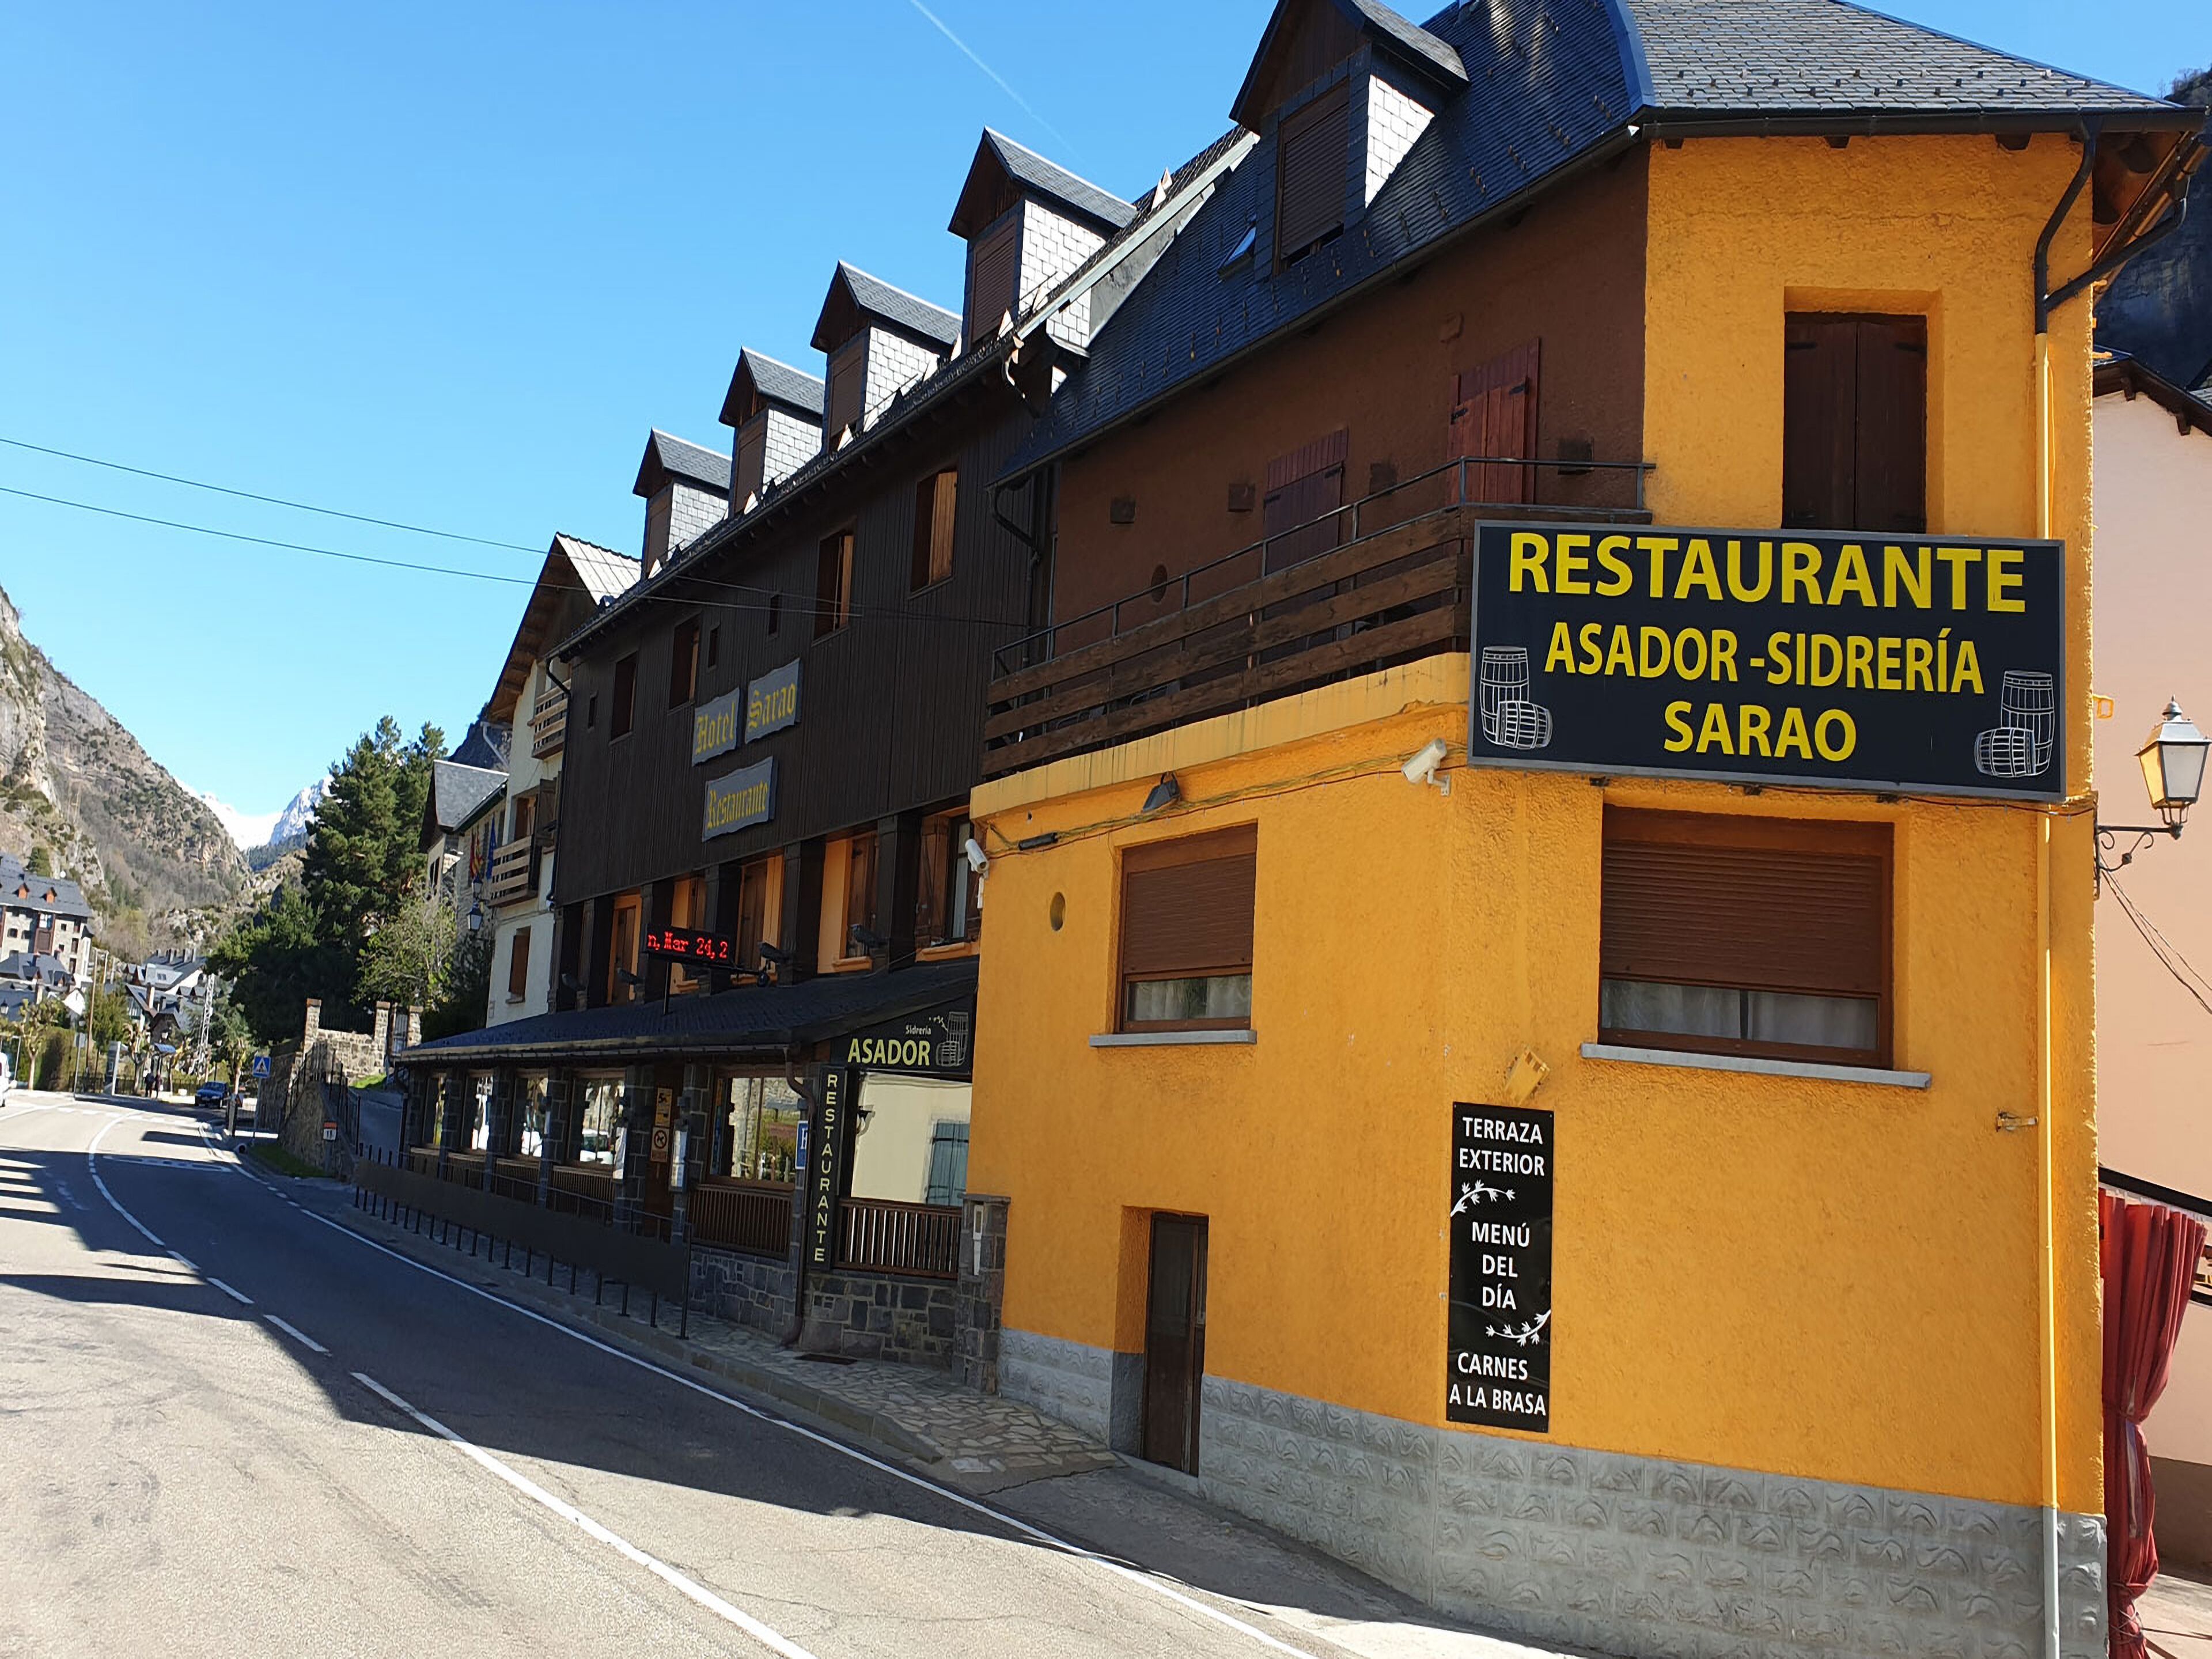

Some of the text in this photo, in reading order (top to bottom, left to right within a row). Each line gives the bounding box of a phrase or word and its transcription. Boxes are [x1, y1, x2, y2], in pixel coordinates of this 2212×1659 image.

[1509, 532, 2026, 613] RESTAURANTE
[1544, 621, 1738, 683] ASADOR
[695, 682, 797, 755] Hotel Sarao
[1664, 700, 1857, 762] SARAO
[707, 780, 768, 830] Restaurante
[664, 931, 689, 952] Mar
[847, 1038, 931, 1066] ASADOR
[1462, 1116, 1544, 1145] TERRAZA
[814, 1074, 838, 1262] RESTAURANTE
[1459, 1147, 1545, 1176] EXTERIOR
[1472, 1221, 1530, 1248] MENÚ
[1482, 1253, 1518, 1278] DEL
[1482, 1283, 1517, 1310] DÍA
[1457, 1352, 1528, 1381] CARNES
[1449, 1383, 1547, 1416] A LA BRASA
